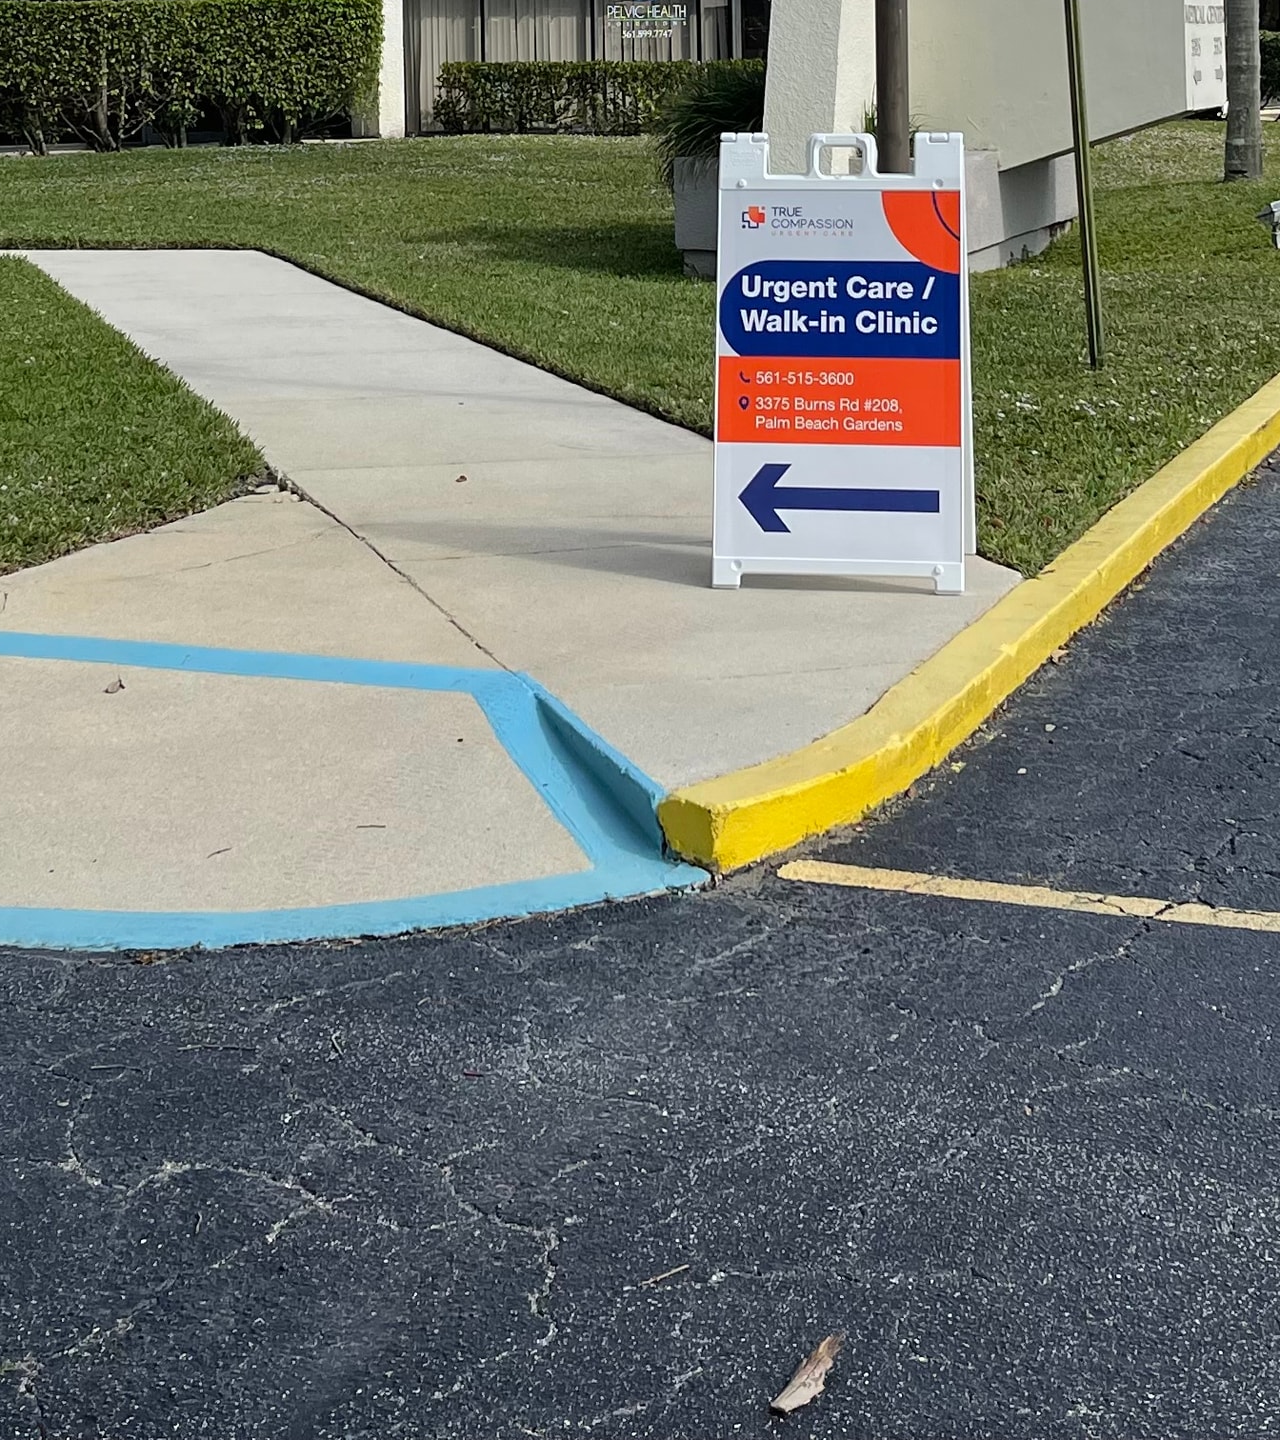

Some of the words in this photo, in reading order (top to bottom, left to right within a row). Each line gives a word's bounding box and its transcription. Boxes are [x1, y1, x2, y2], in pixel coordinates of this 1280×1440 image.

[607, 5, 645, 18] PELVIC
[647, 4, 686, 18] HEALTH
[771, 207, 802, 217] TRUE
[771, 219, 854, 229] COMPASSION
[741, 275, 837, 303] Urgent
[846, 276, 914, 299] Care
[922, 276, 936, 300] /
[740, 309, 845, 333] Walk-in
[855, 310, 938, 334] Clinic
[755, 371, 854, 385] 561-515-3600
[755, 397, 790, 410] 3375
[794, 398, 836, 411] Burns
[839, 398, 859, 411] Rd
[864, 399, 903, 414] #208,
[755, 415, 790, 429] Palm
[795, 416, 838, 430] Beach
[843, 417, 903, 431] Gardens
